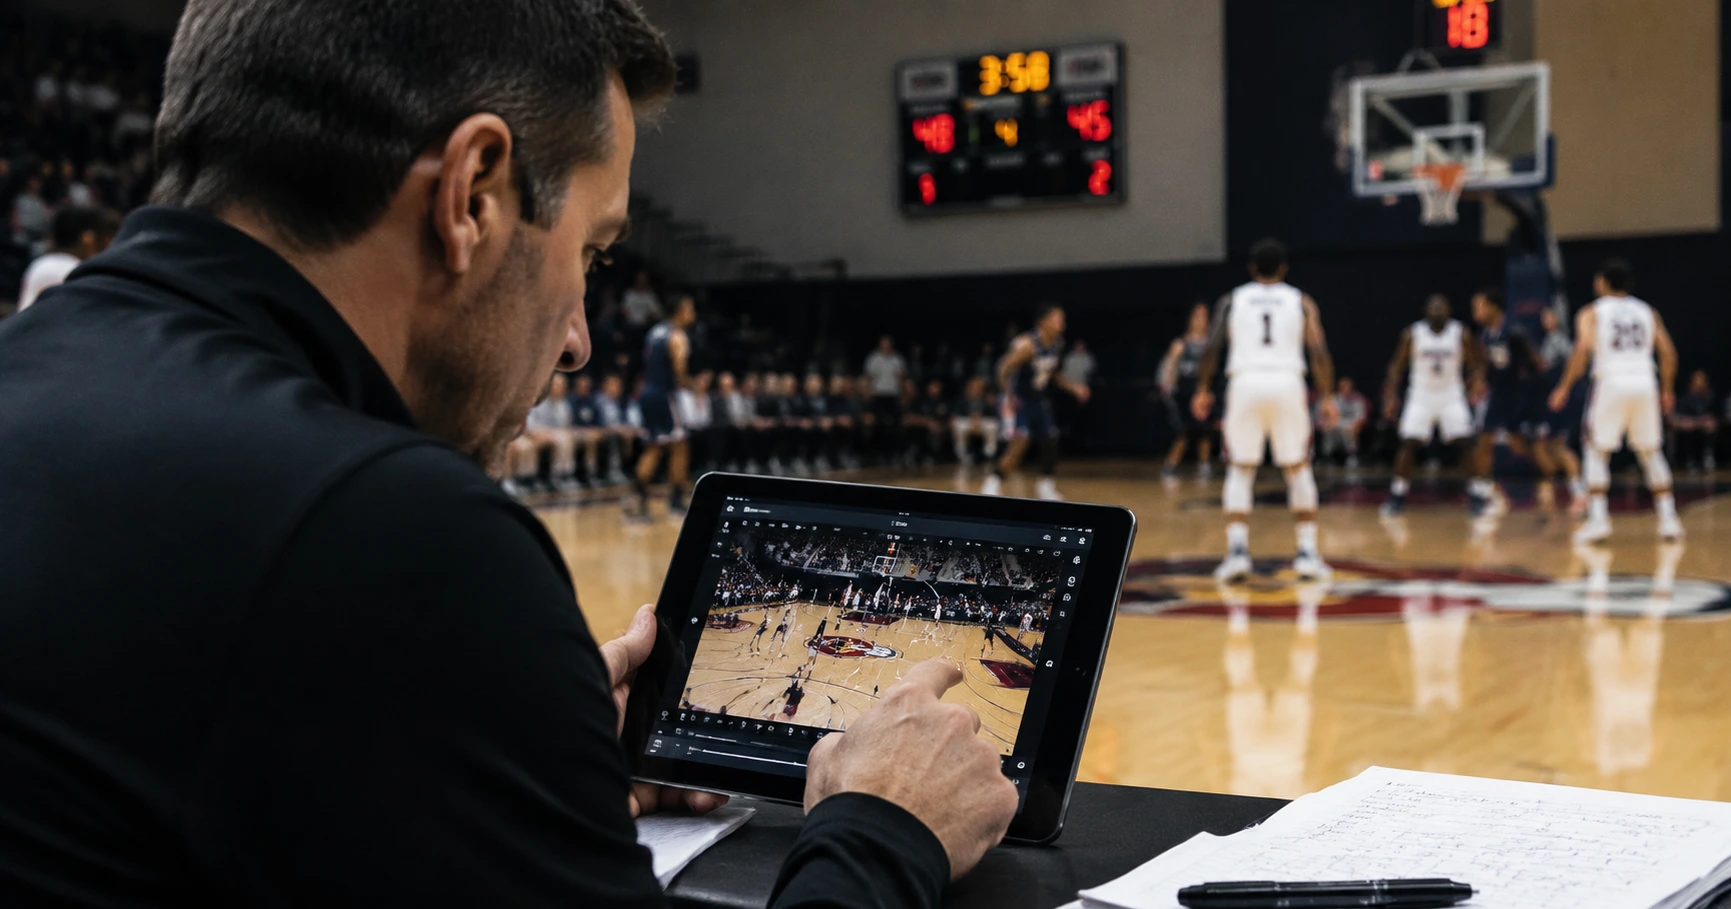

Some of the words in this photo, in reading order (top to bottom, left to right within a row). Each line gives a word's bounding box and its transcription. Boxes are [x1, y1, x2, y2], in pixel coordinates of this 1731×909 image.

[1067, 100, 1112, 141] 45
[1088, 159, 1112, 195] 2
[1261, 312, 1273, 346] 1
